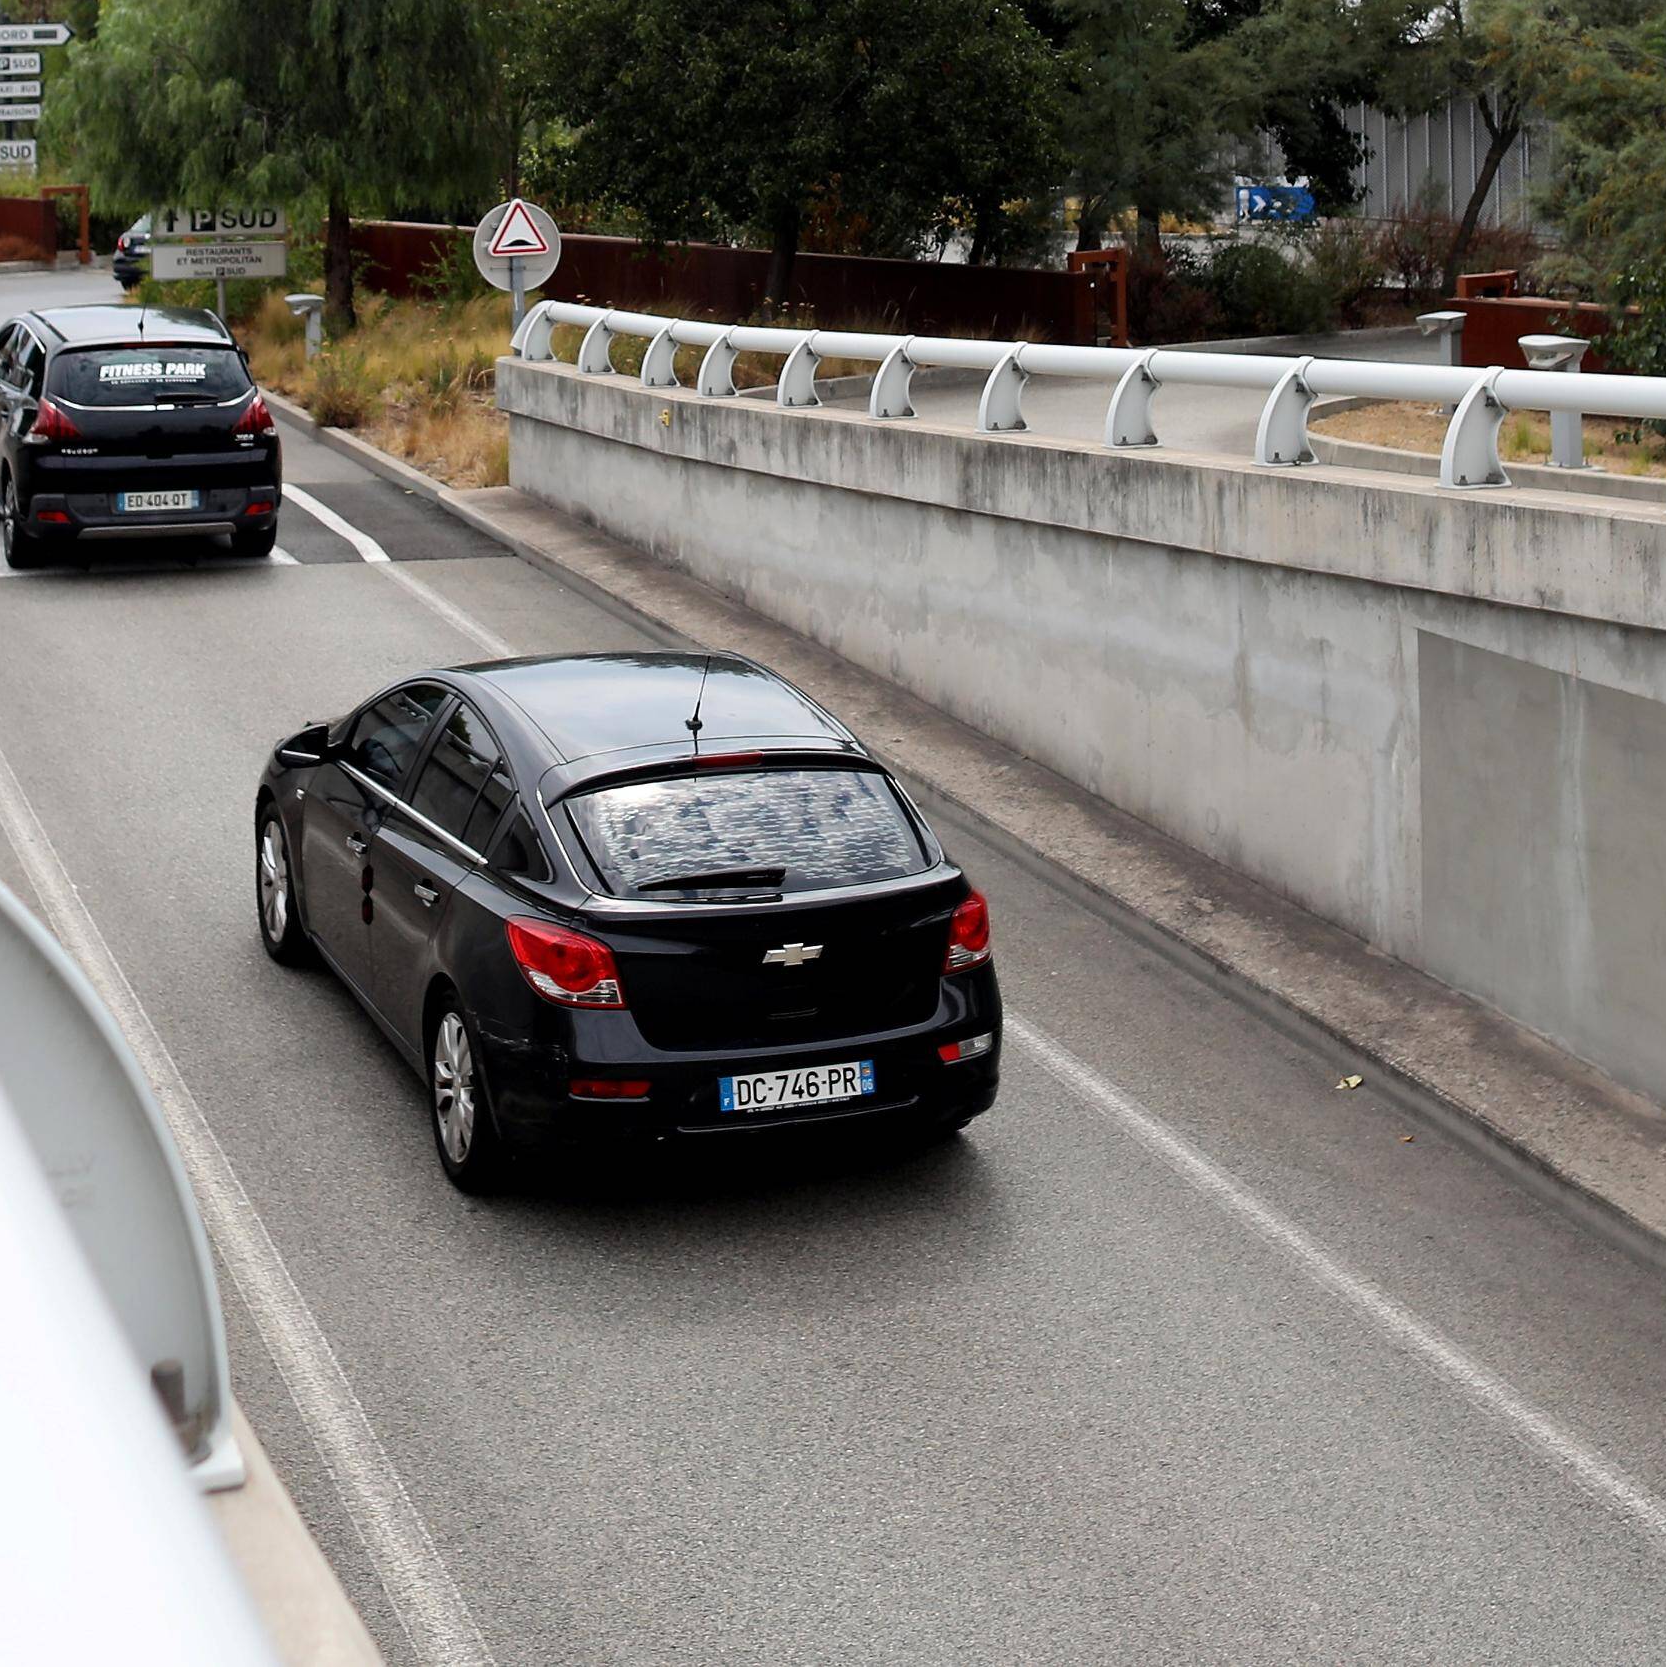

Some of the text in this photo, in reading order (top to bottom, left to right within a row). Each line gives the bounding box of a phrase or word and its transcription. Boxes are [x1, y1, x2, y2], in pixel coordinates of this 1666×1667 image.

[13, 57, 37, 69] SUD
[0, 145, 32, 159] SUD
[220, 208, 277, 229] SUD
[186, 246, 253, 257] RESTAURANTS
[176, 255, 262, 266] ET METROPOLITAN
[100, 361, 207, 379] FITNESS PARK
[737, 1066, 857, 1107] DC-746-PR
